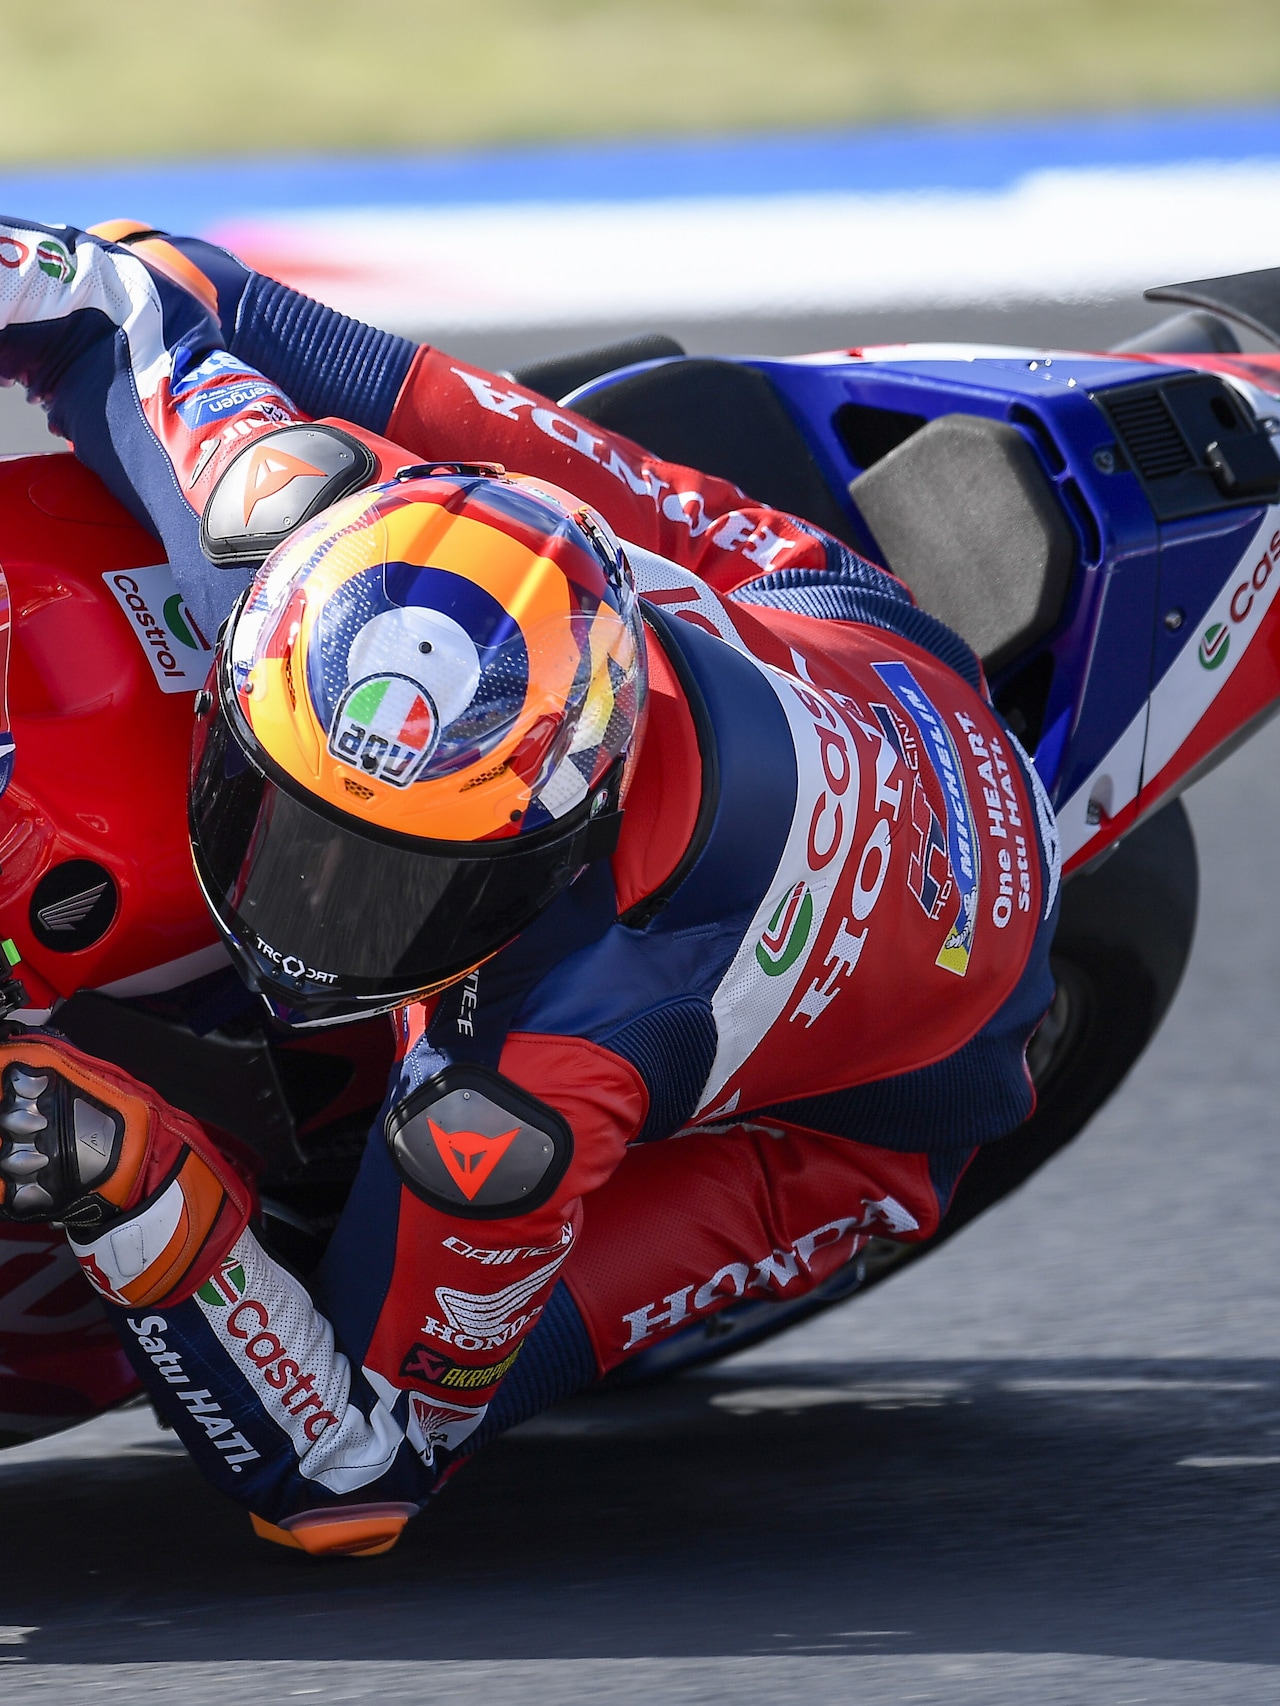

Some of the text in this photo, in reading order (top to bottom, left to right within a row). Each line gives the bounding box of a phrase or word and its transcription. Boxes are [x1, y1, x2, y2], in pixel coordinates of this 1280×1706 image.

[450, 366, 796, 572] HONDA
[112, 574, 187, 677] Castrol
[337, 722, 417, 777] agv
[899, 684, 975, 881] MICHELIN
[954, 710, 1015, 929] One HEART.
[1014, 835, 1032, 913] Satu
[420, 1304, 545, 1351] HONDA
[622, 1194, 921, 1350] HONDA
[126, 1314, 262, 1473] Satu HATI.
[226, 1299, 340, 1442] Castro
